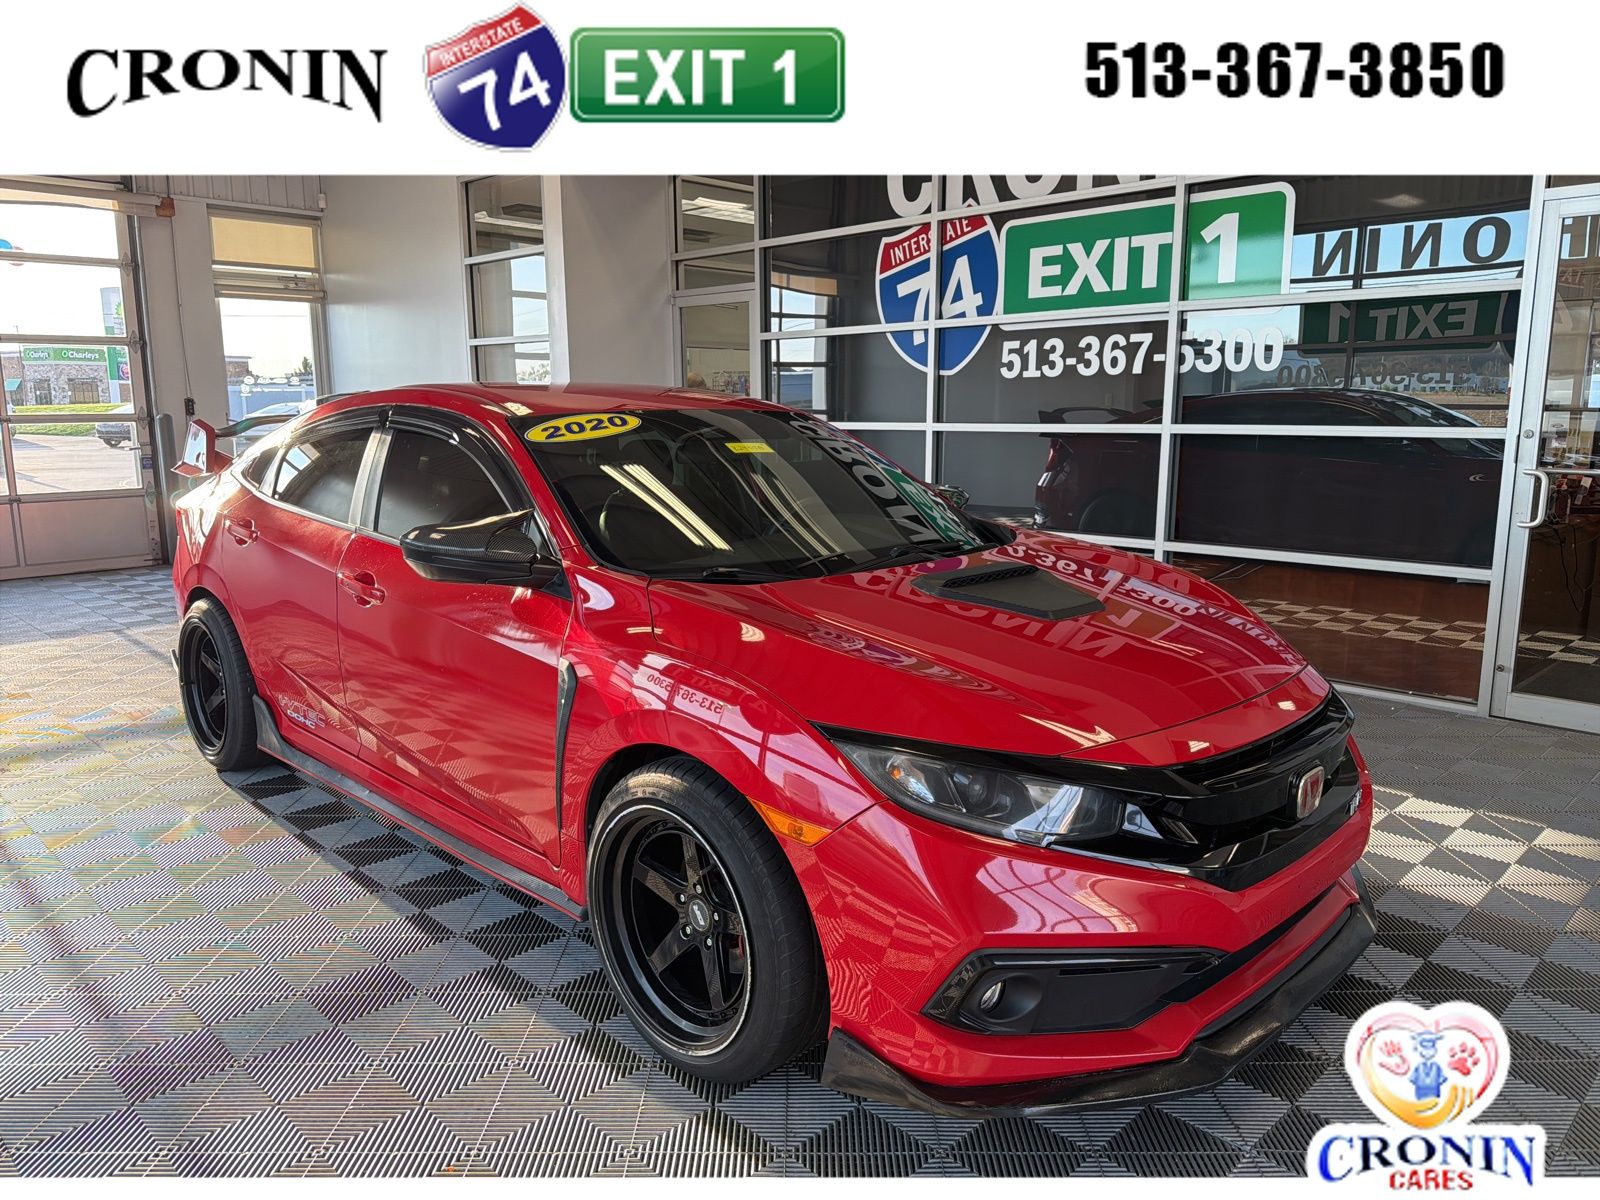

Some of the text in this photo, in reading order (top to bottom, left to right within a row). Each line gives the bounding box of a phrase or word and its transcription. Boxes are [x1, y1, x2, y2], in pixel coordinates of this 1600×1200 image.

[890, 216, 973, 266] INTERSATE
[1028, 212, 1240, 299] EXIT 1
[896, 254, 984, 346] 74
[541, 415, 629, 440] 2020
